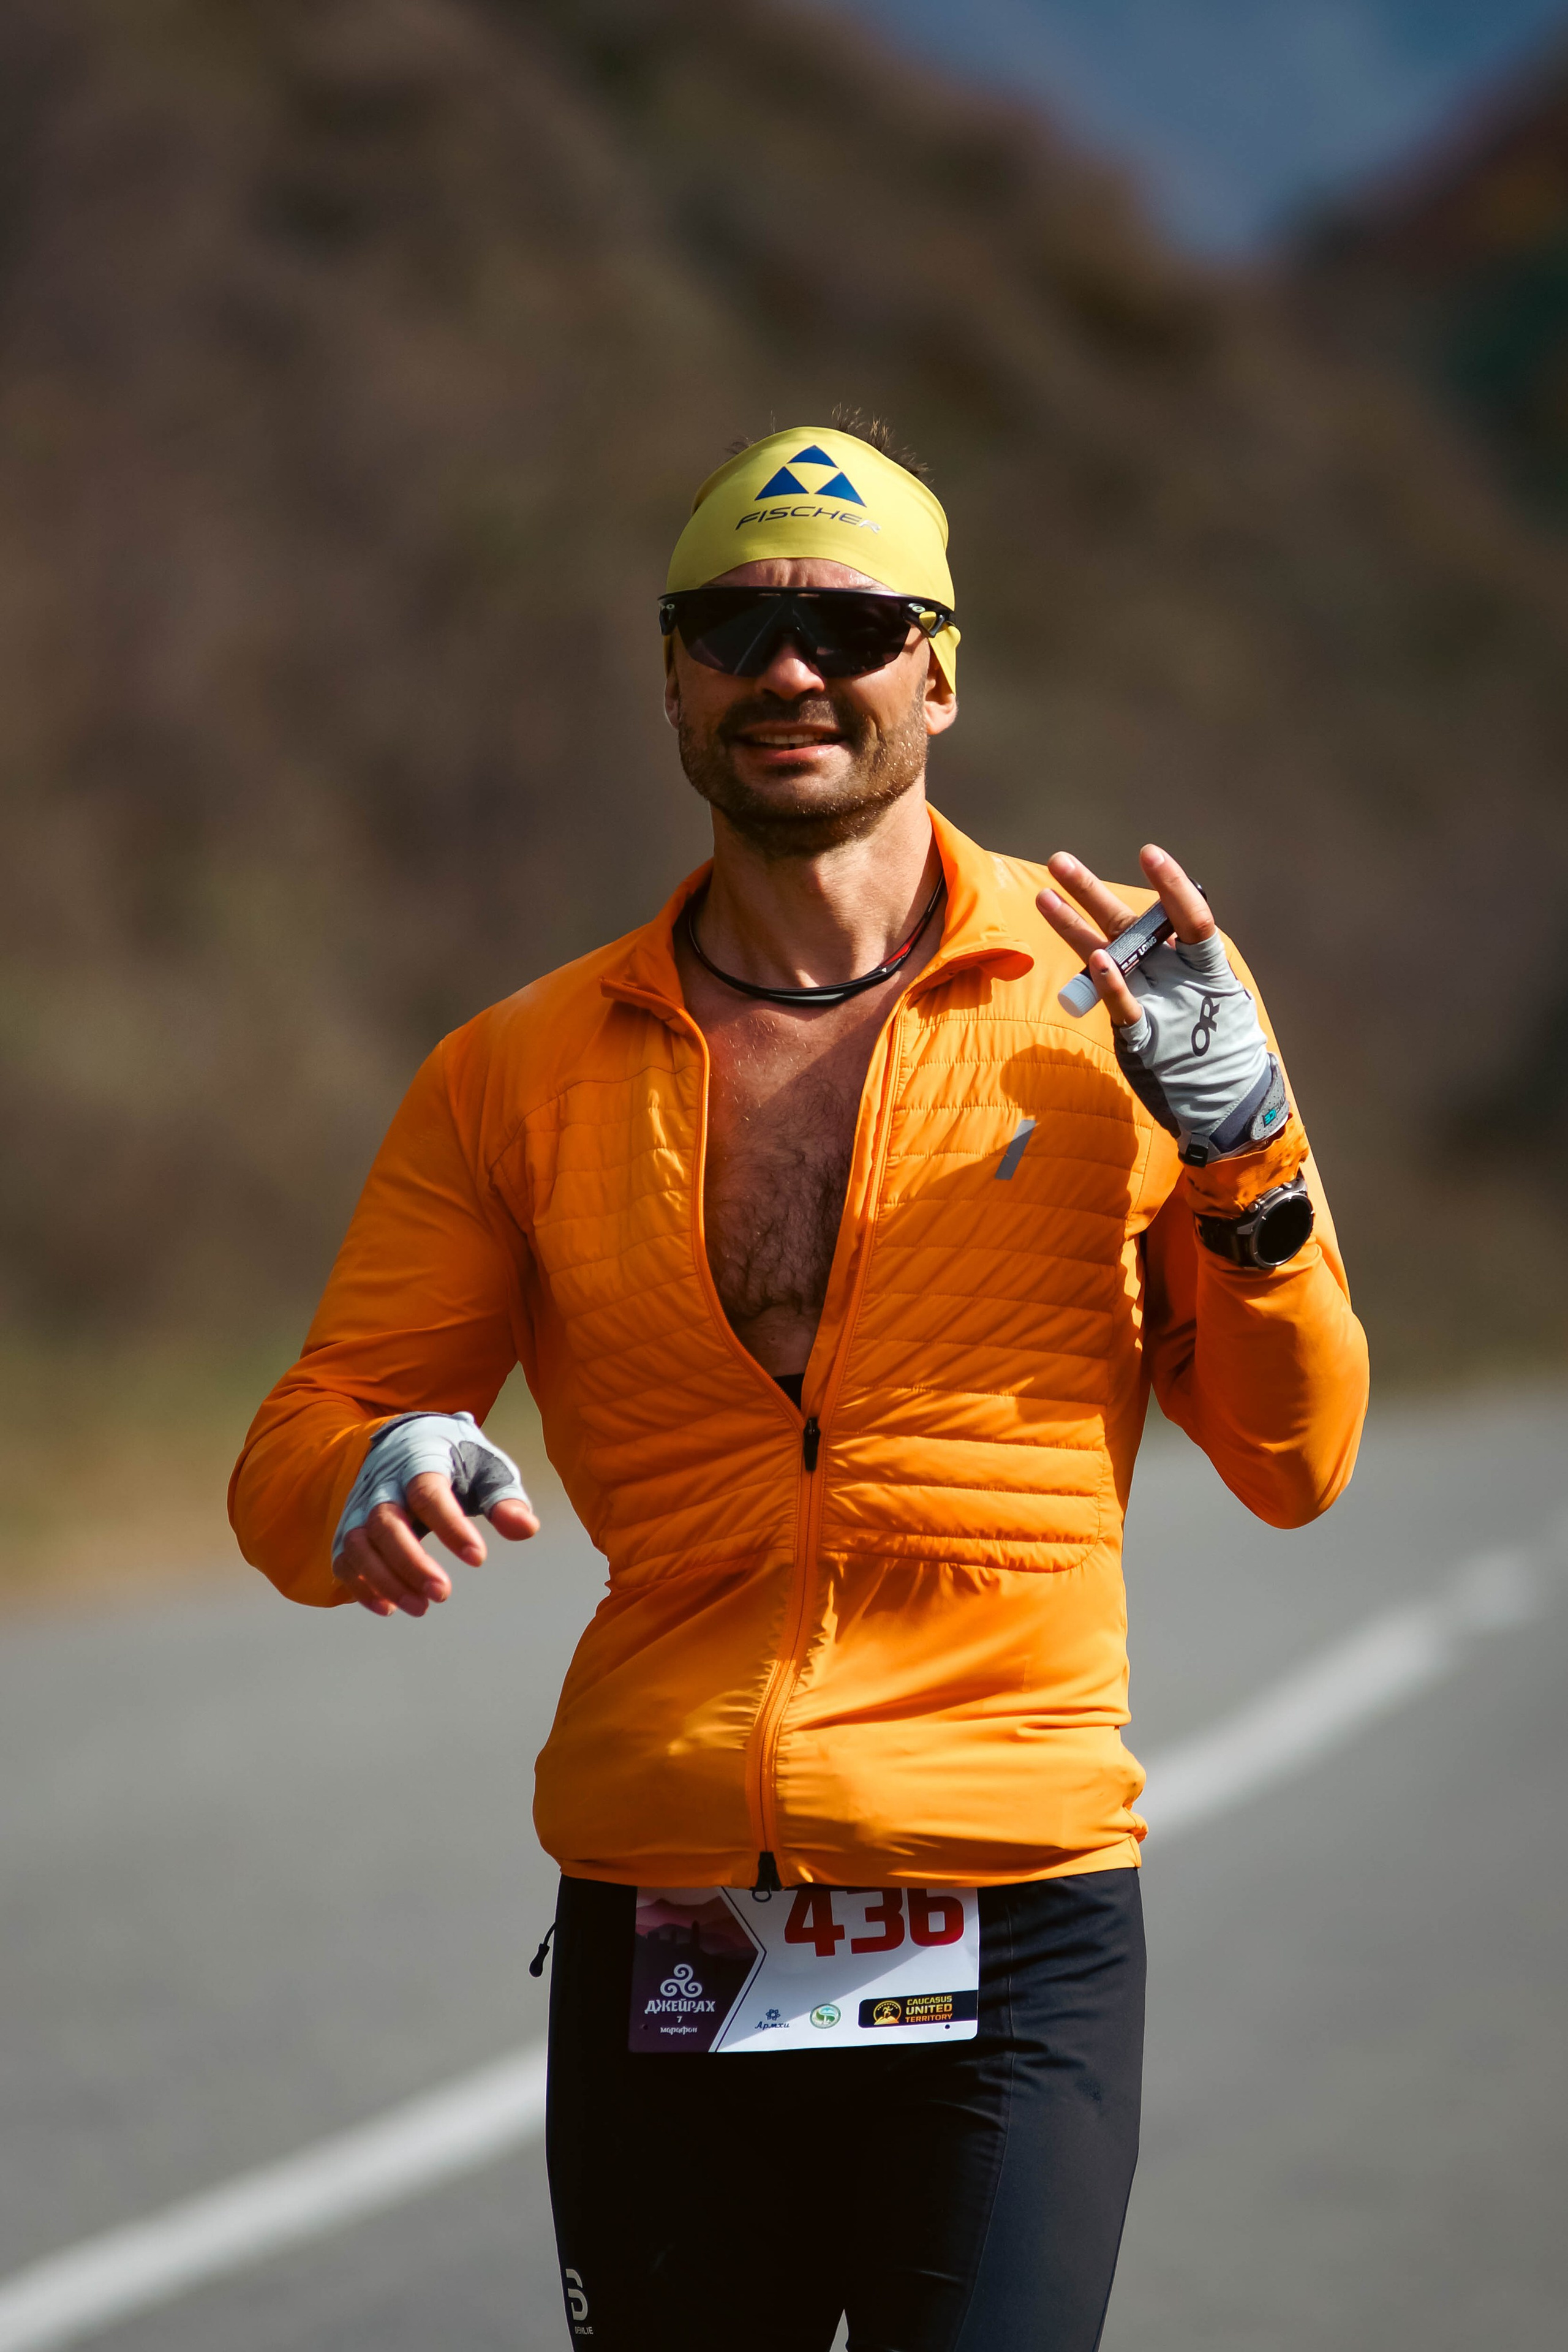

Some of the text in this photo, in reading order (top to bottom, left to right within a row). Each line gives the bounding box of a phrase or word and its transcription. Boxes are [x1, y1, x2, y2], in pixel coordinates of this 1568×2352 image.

[735, 506, 881, 534] FISCHER
[1138, 936, 1157, 956] LONG
[785, 1887, 965, 1957] 436
[644, 1999, 715, 2014] ДЖЕЙРАХ
[907, 1996, 952, 2006] CAUCASUS
[906, 2003, 952, 2015] UNITED
[905, 2013, 953, 2023] TERRITORY
[660, 2026, 697, 2035] марафон
[755, 2021, 790, 2030] Армхи
